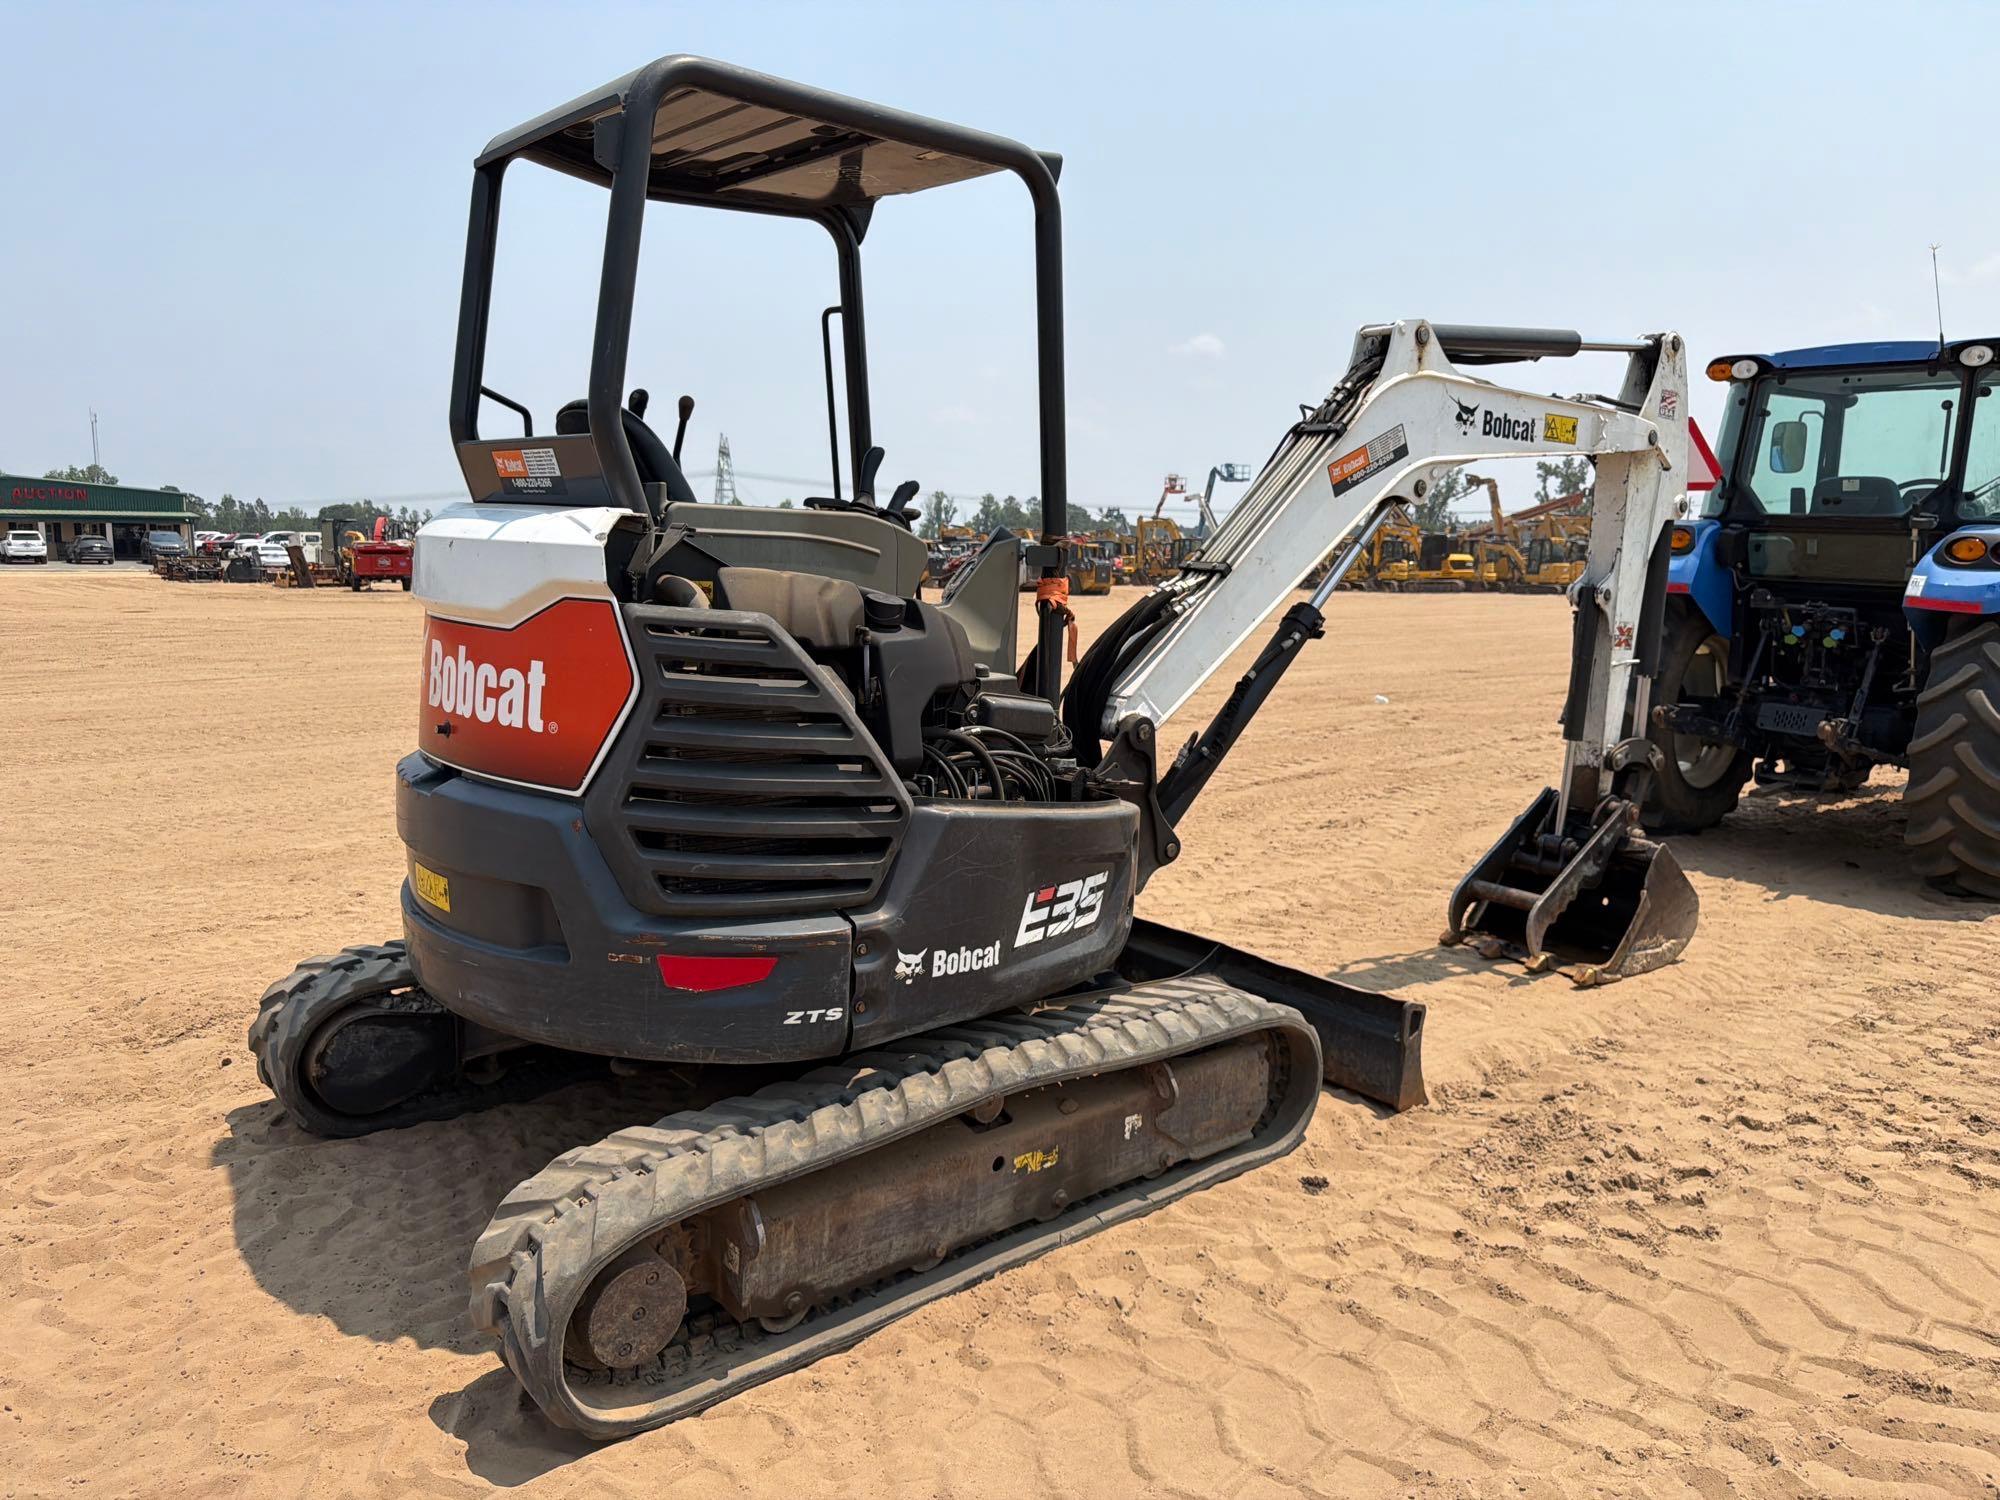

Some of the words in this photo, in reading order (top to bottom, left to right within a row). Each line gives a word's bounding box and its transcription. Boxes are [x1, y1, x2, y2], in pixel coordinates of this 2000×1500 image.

[1482, 410, 1536, 442] Bobcat
[12, 486, 87, 500] AUCTION
[428, 638, 546, 733] Bobcat
[1013, 870, 1109, 948] E35
[931, 940, 1000, 977] Bobcat
[783, 1007, 843, 1024] ZTS
